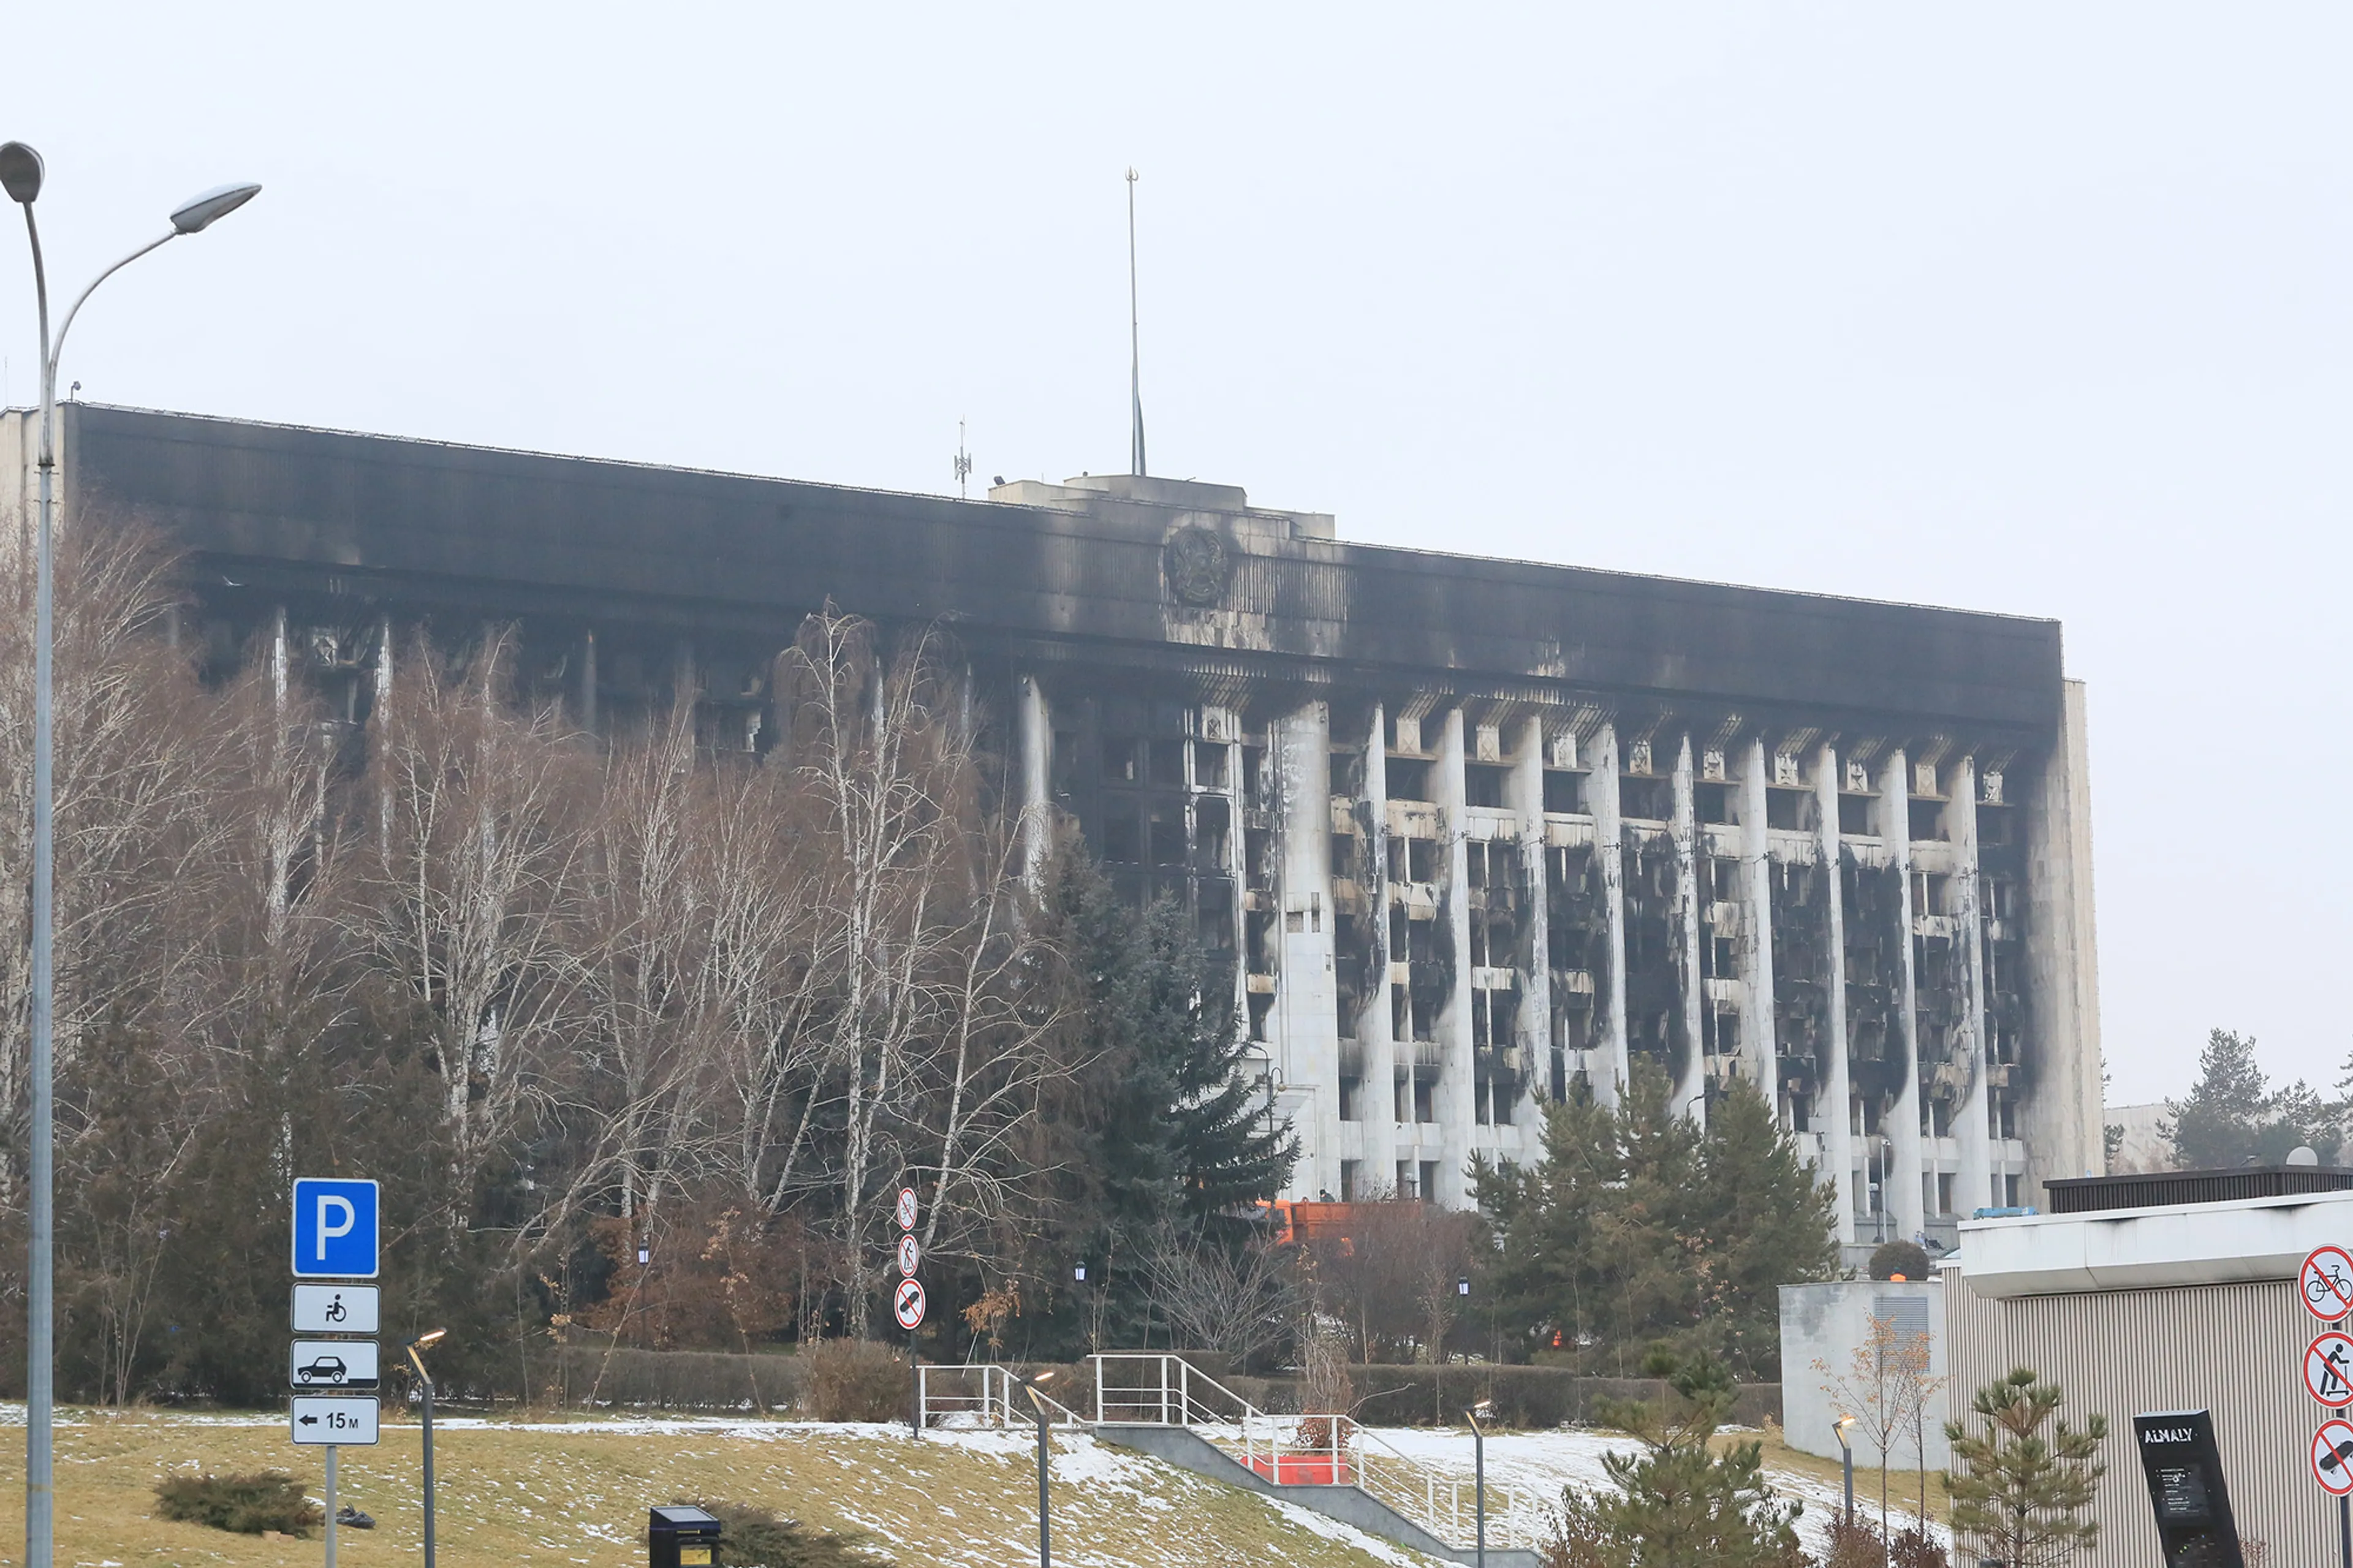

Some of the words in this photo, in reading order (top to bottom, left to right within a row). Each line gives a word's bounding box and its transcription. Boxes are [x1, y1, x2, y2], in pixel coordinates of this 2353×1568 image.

[316, 1195, 355, 1260] P
[327, 1412, 346, 1429] 15
[2145, 1428, 2192, 1443] ALMALY
